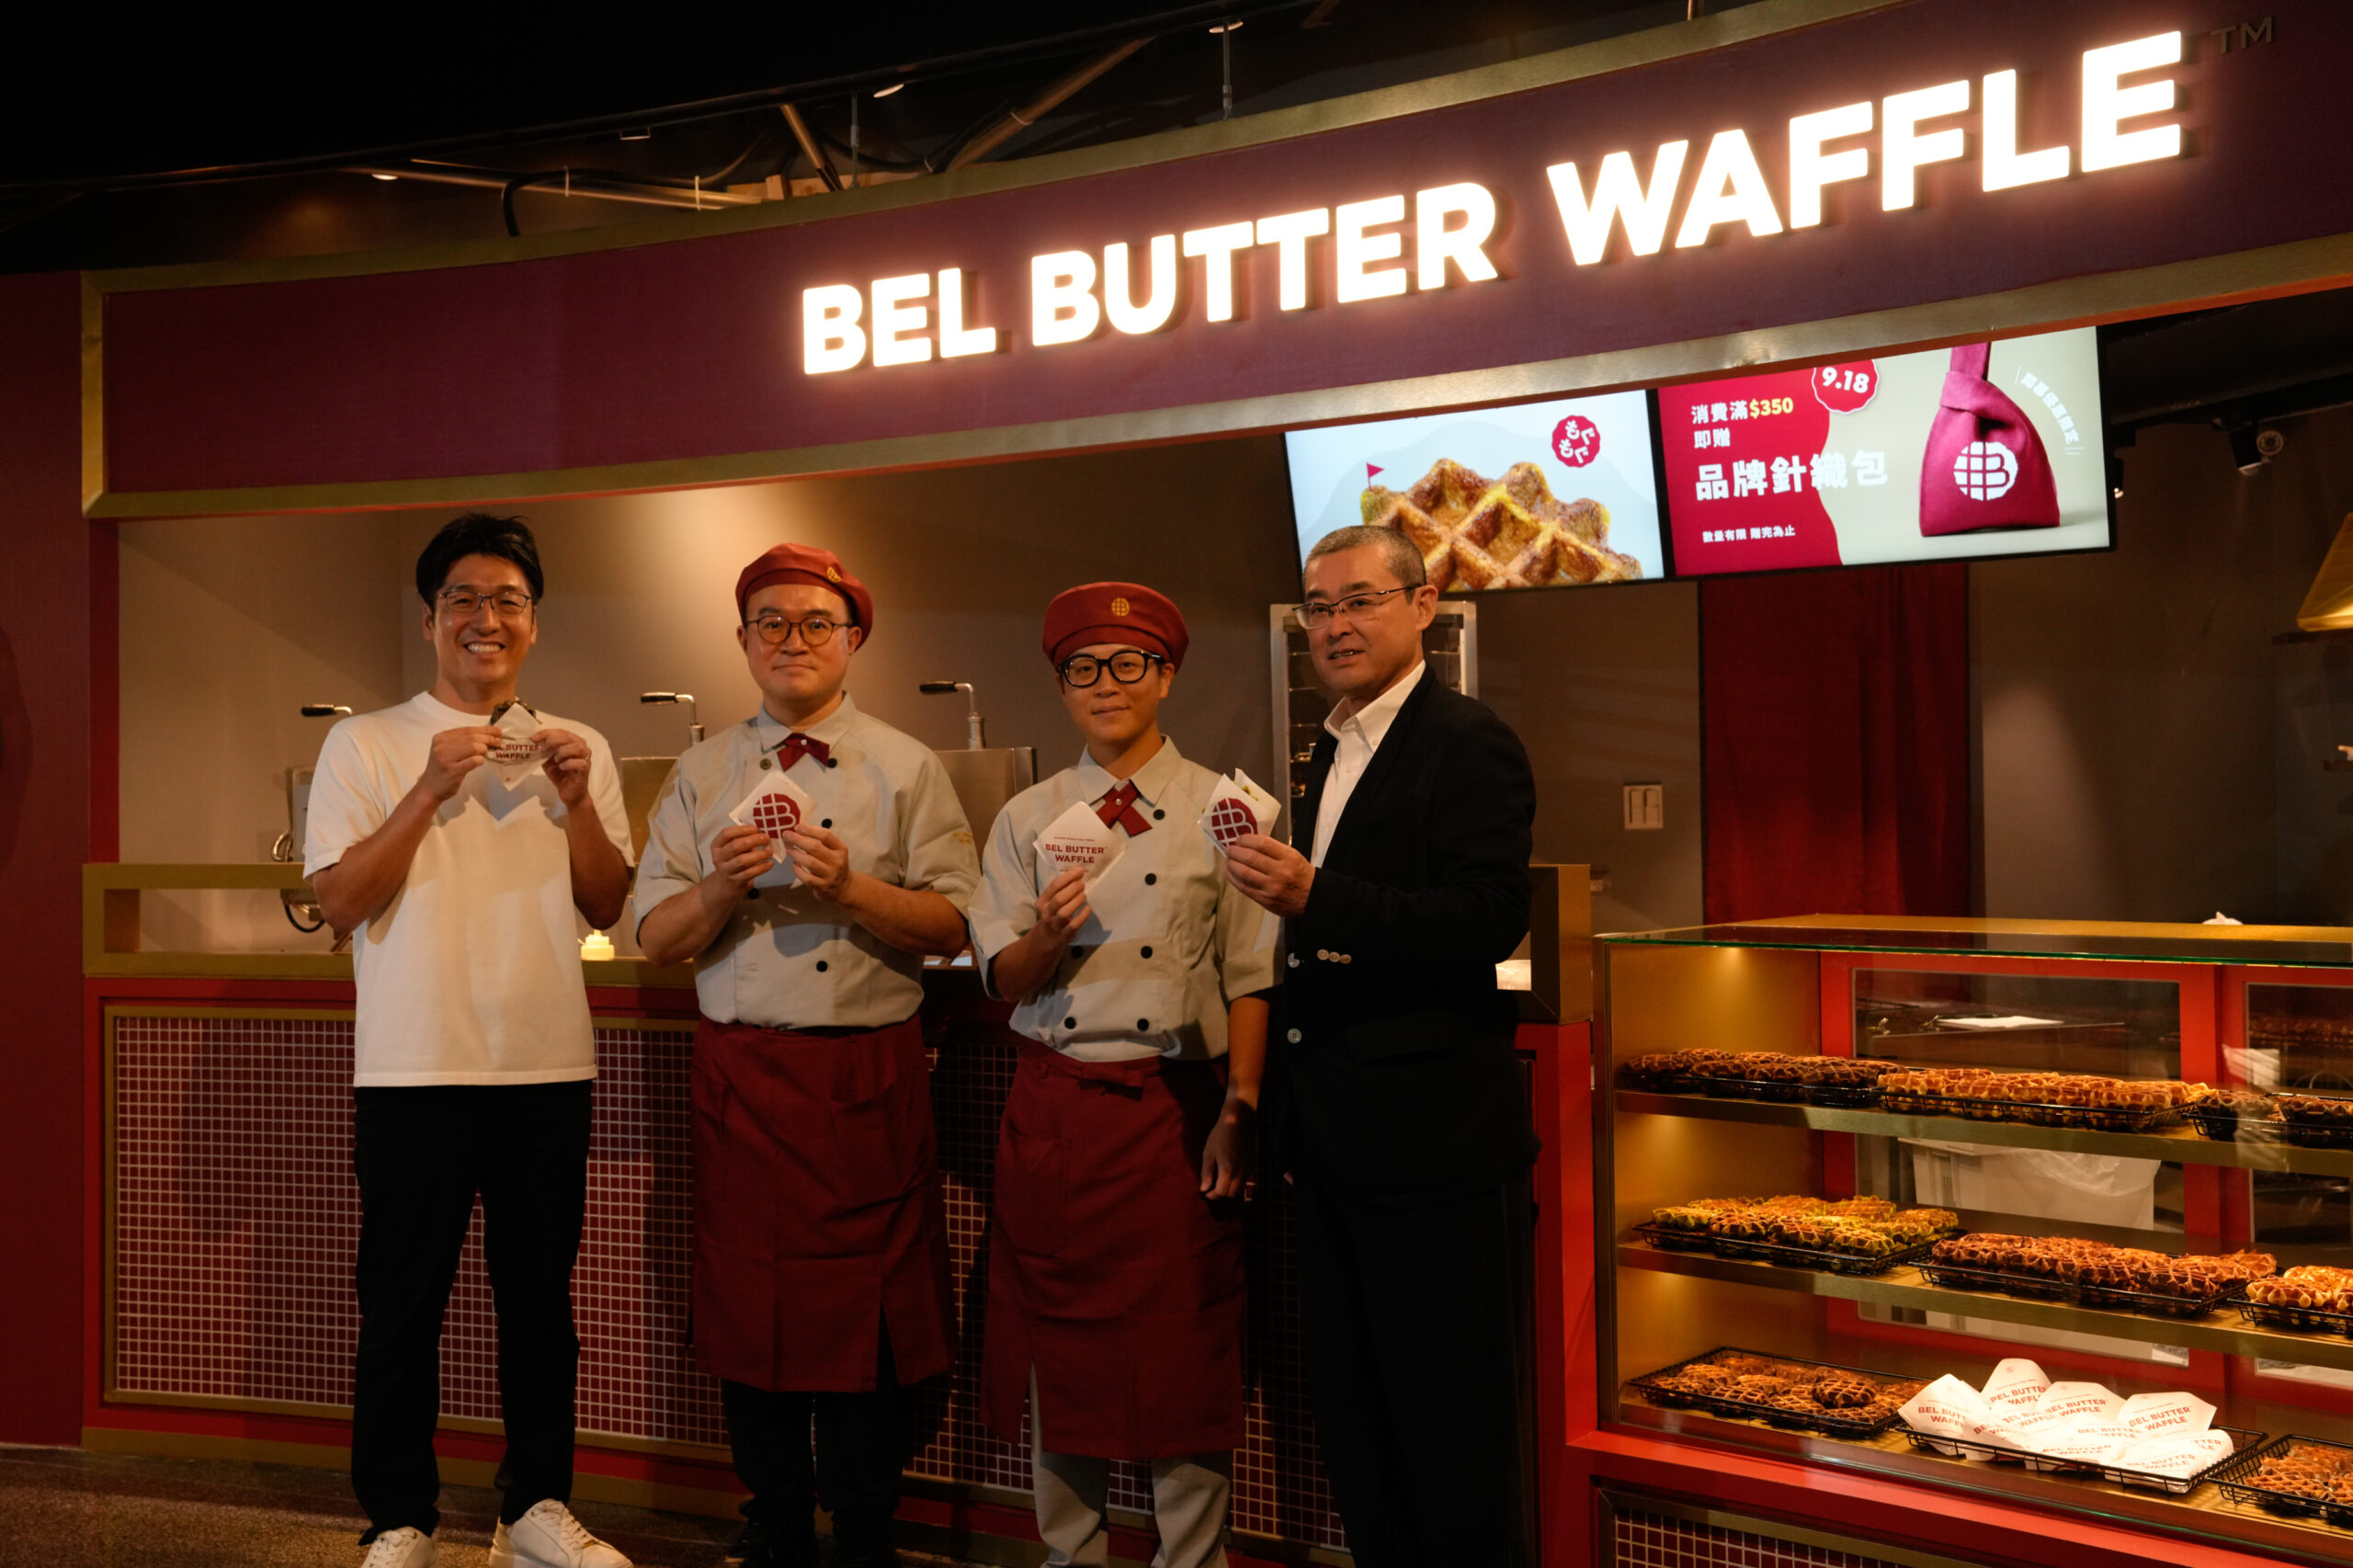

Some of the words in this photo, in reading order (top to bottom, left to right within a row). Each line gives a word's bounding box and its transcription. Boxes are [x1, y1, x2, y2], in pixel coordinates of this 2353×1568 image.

[802, 267, 996, 374] BEL
[1031, 182, 1497, 347] BUTTER
[1546, 30, 2181, 266] WAFFLE
[1823, 367, 1870, 393] 9.18
[1694, 427, 1731, 449] 即贈
[1696, 449, 1888, 501] 品牌針織包
[1045, 844, 1063, 852] BEL
[1065, 846, 1104, 854] BUTTER
[1055, 855, 1095, 863] WAFFLE
[2007, 1395, 2040, 1404] WAFFL
[2066, 1399, 2106, 1408] BUTTER
[1941, 1408, 1966, 1419] BUTT
[2060, 1406, 2102, 1416] WAFFLE
[2128, 1416, 2149, 1427] BEL
[2150, 1406, 2191, 1420] BUTTER
[1931, 1415, 1964, 1427] WAFF
[2144, 1416, 2188, 1431] WAFFLE
